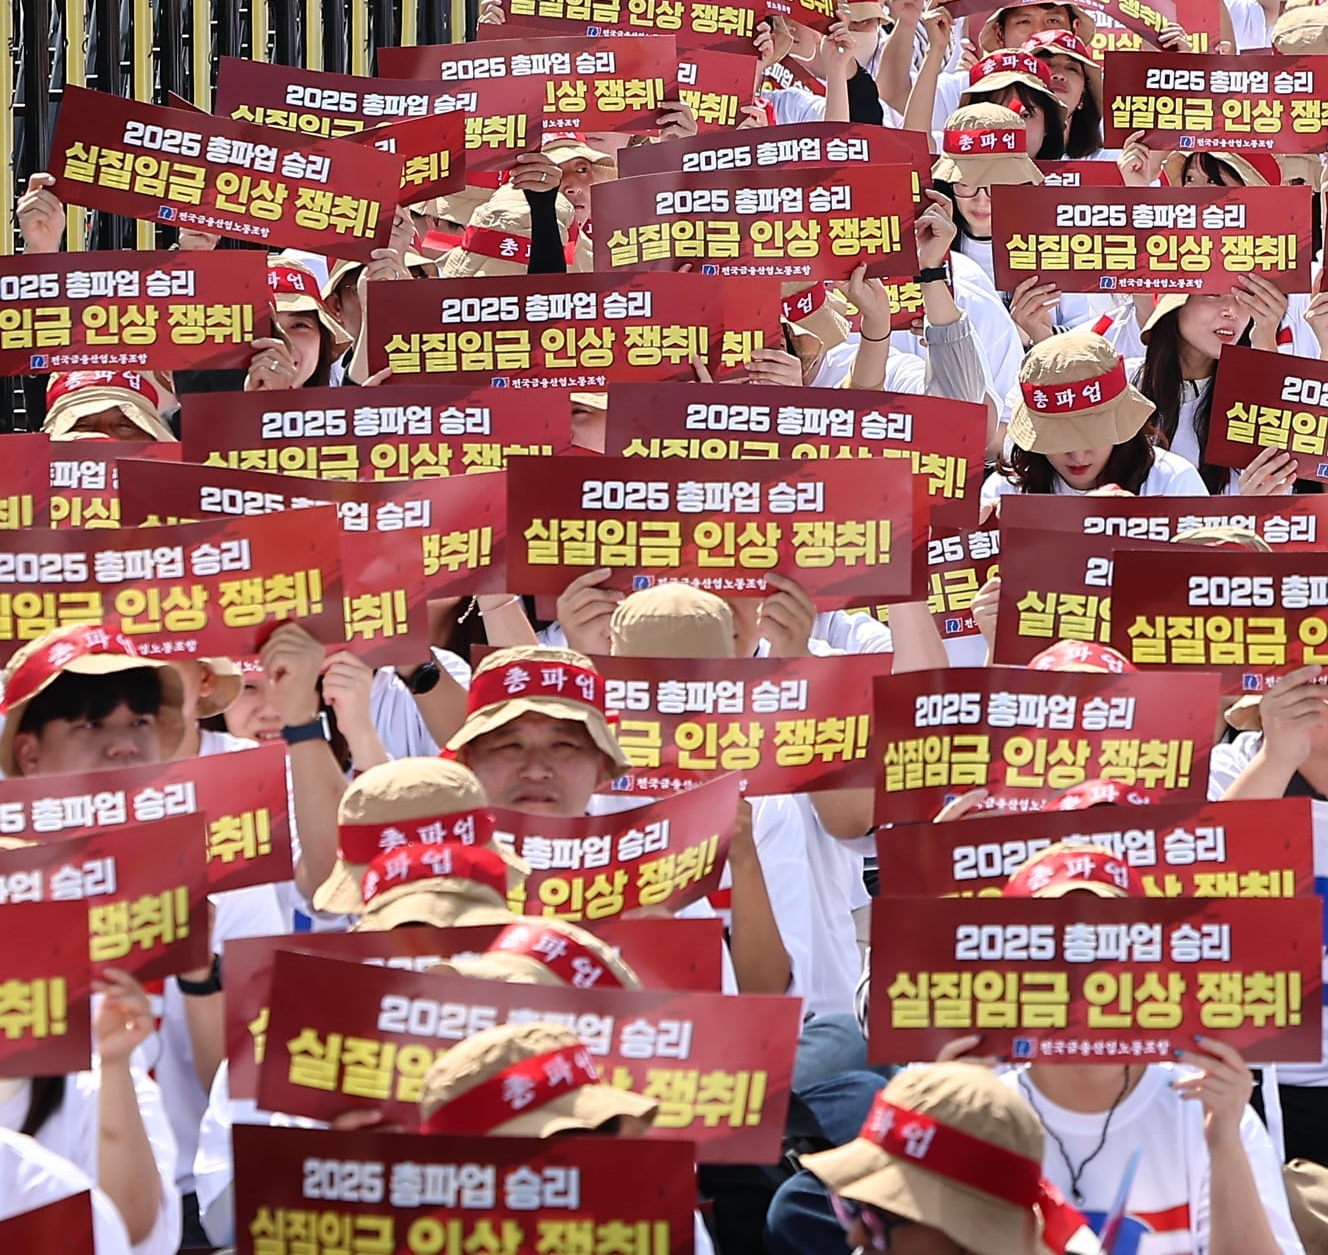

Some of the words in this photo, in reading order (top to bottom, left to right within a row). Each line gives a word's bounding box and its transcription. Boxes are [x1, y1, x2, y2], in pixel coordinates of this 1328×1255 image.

[982, 55, 1037, 75] 총파업
[122, 120, 202, 156] 2025
[205, 135, 278, 172] 총파업
[281, 151, 330, 182] 승리
[959, 133, 1015, 152] 총파업
[63, 141, 206, 204] 실질임금
[215, 170, 288, 220] 인상
[294, 186, 379, 238] 쟁취!
[1056, 203, 1126, 227] 2025
[1131, 203, 1196, 229] 총파업
[1202, 203, 1245, 229] 승리
[1004, 233, 1136, 269] 실질임금
[1144, 233, 1213, 271] 인상
[1219, 233, 1296, 271] 쟁취!
[1033, 382, 1101, 408] 총파업
[581, 480, 669, 509] 2025
[676, 480, 760, 512] 총파업
[767, 480, 823, 512] 승리
[523, 517, 681, 571] 실질임금
[693, 519, 781, 567] 인상
[791, 518, 890, 567] 쟁취!
[1187, 575, 1274, 606] 2025
[1122, 615, 1287, 665] 실질임금
[502, 667, 596, 702] 총파업
[955, 925, 1054, 959] 2025
[1063, 921, 1161, 963] 총파업
[1170, 923, 1229, 961] 승리
[887, 969, 1069, 1027] 실질임금
[1083, 971, 1185, 1029] 인상
[1196, 971, 1300, 1027] 쟁취!
